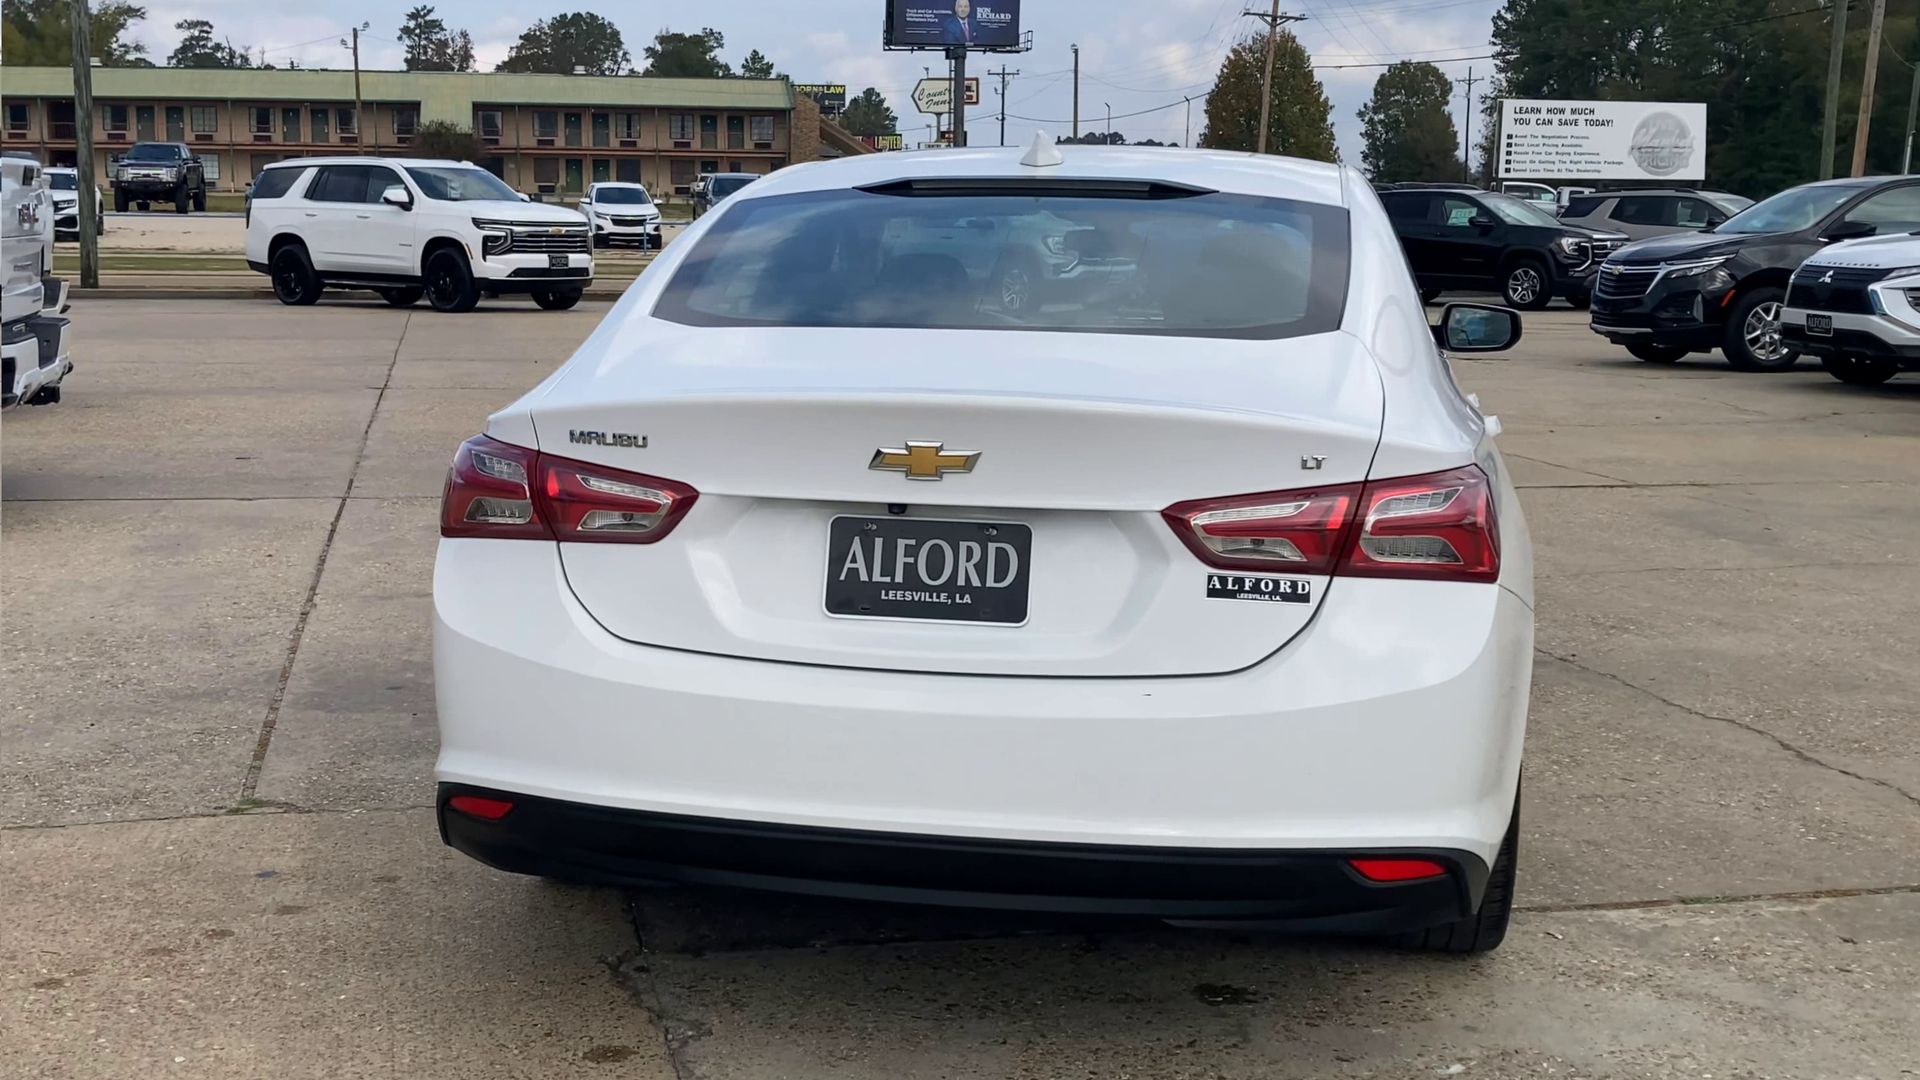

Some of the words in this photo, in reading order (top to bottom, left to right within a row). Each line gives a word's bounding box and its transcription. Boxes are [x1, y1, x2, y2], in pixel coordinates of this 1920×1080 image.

[917, 87, 952, 101] Count
[1513, 106, 1542, 115] LEARN
[1546, 107, 1566, 115] HOW
[1570, 107, 1595, 116] MUCH
[1513, 118, 1531, 126] YOU
[1535, 118, 1553, 126] CAN
[1557, 119, 1580, 127] SAVE
[1584, 119, 1614, 127] TODAY!
[569, 429, 649, 448] MALIBU
[1300, 455, 1328, 470] LT
[838, 535, 1019, 588] ALFORD
[1208, 575, 1311, 594] ALFORD
[881, 589, 952, 605] LEESVILLE,
[955, 593, 972, 604] LA
